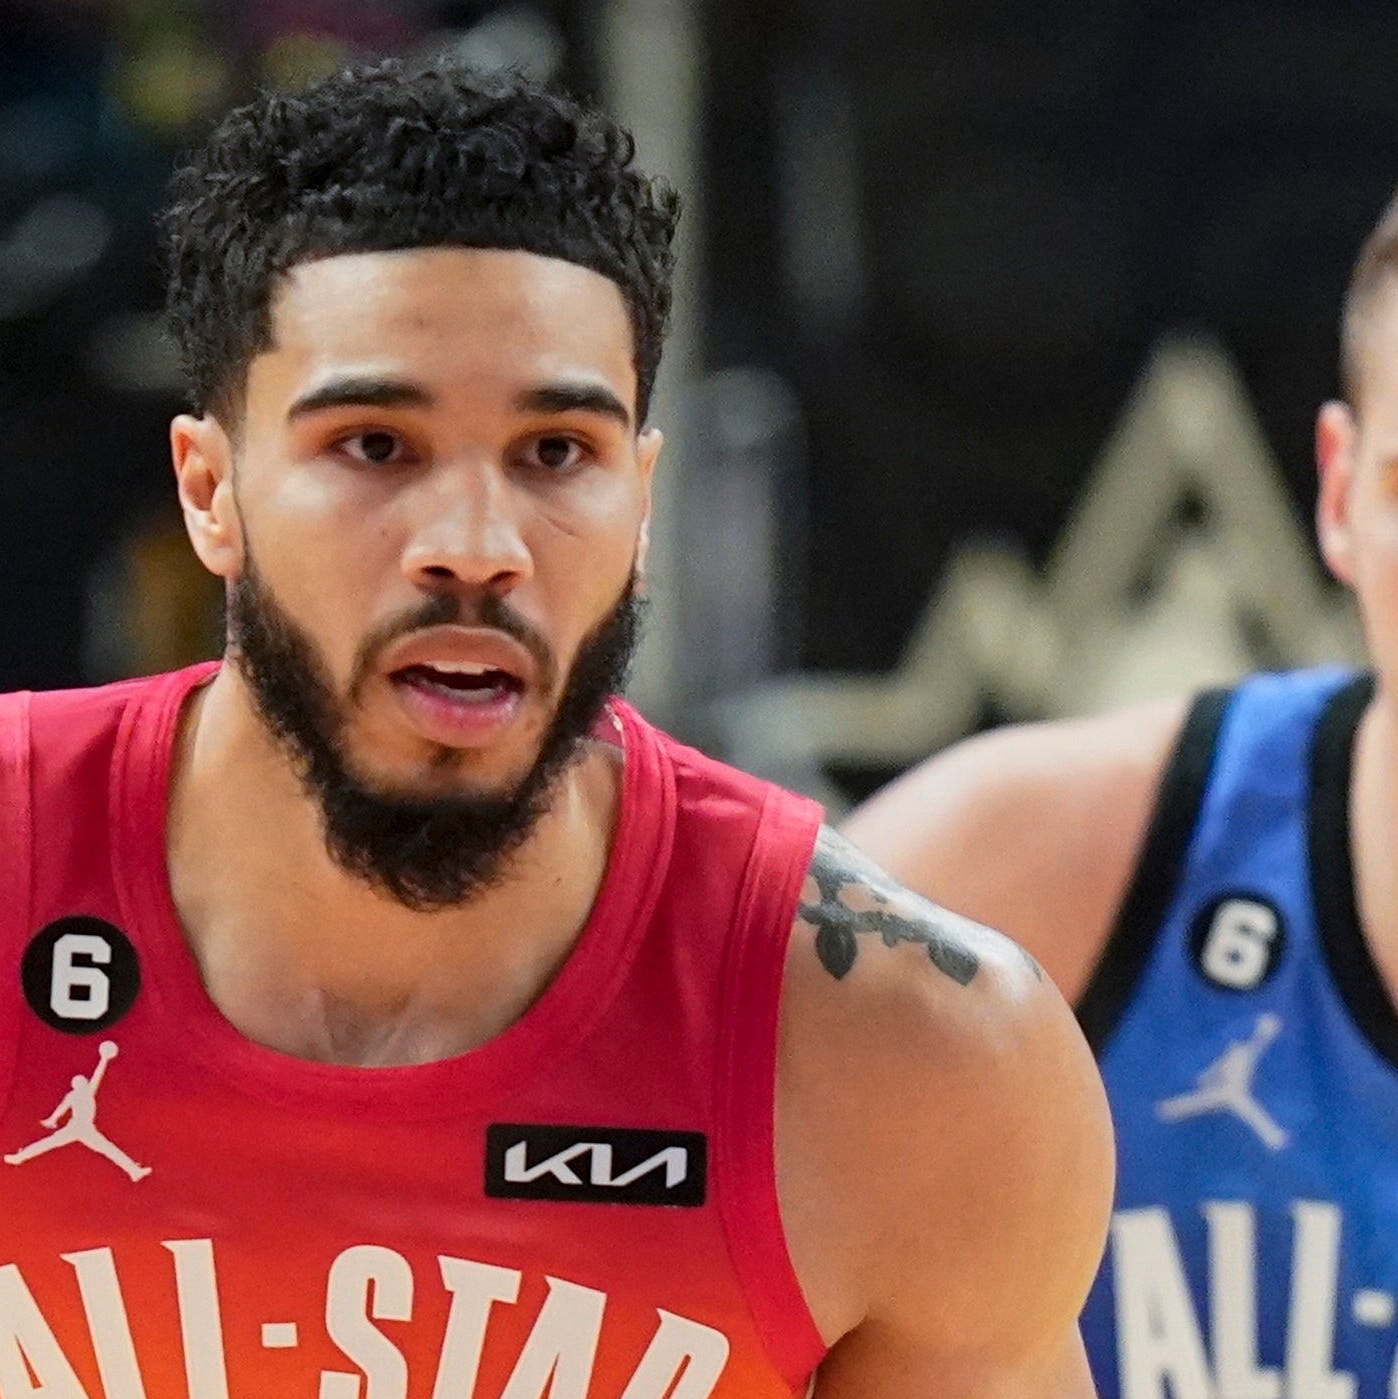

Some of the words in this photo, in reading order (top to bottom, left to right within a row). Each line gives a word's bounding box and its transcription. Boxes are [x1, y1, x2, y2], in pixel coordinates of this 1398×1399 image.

[49, 932, 113, 1021] 6
[1201, 897, 1279, 989] 6
[503, 1139, 688, 1190] KIA
